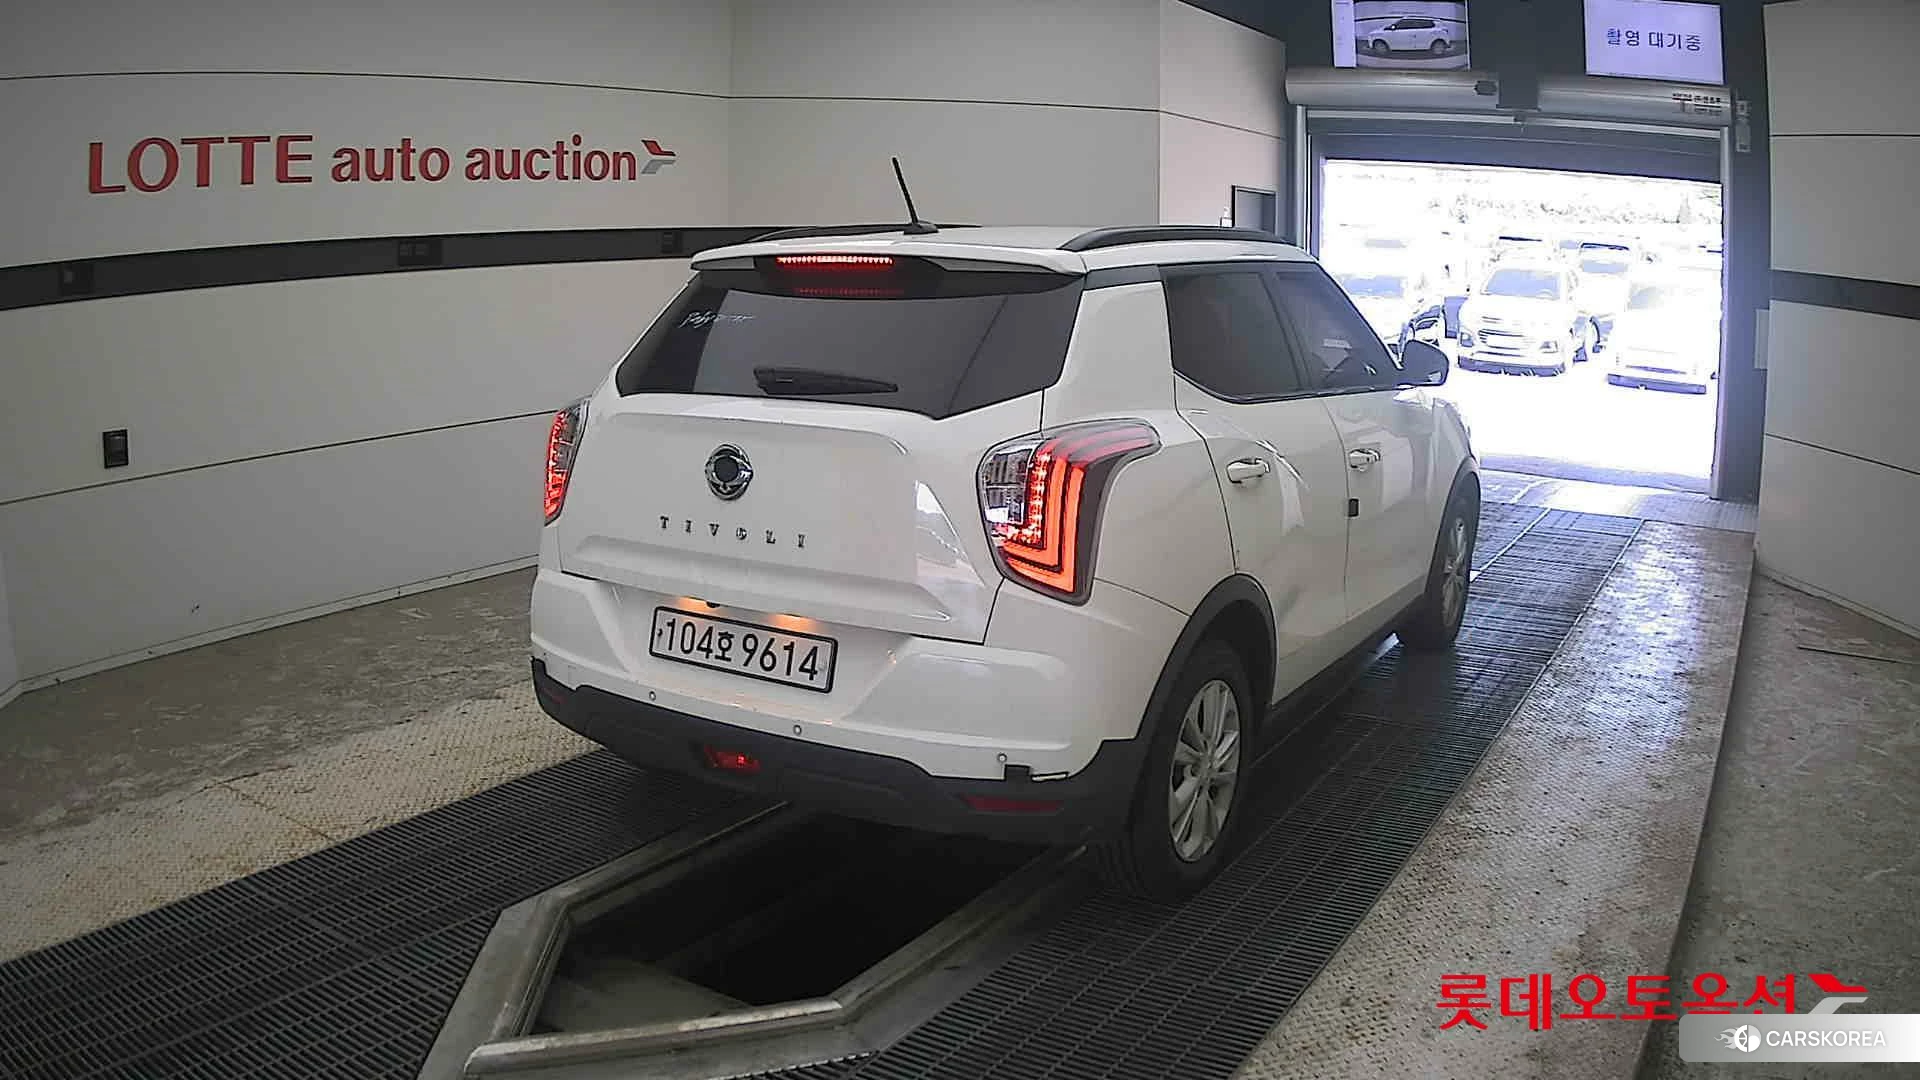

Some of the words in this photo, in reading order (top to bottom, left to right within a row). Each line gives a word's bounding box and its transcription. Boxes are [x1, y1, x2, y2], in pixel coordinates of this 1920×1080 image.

[1648, 31, 1702, 52] 대기중
[88, 135, 314, 194] LOTTE
[331, 137, 450, 183] auto
[464, 134, 638, 182] auction
[660, 515, 806, 549] TIVOLI
